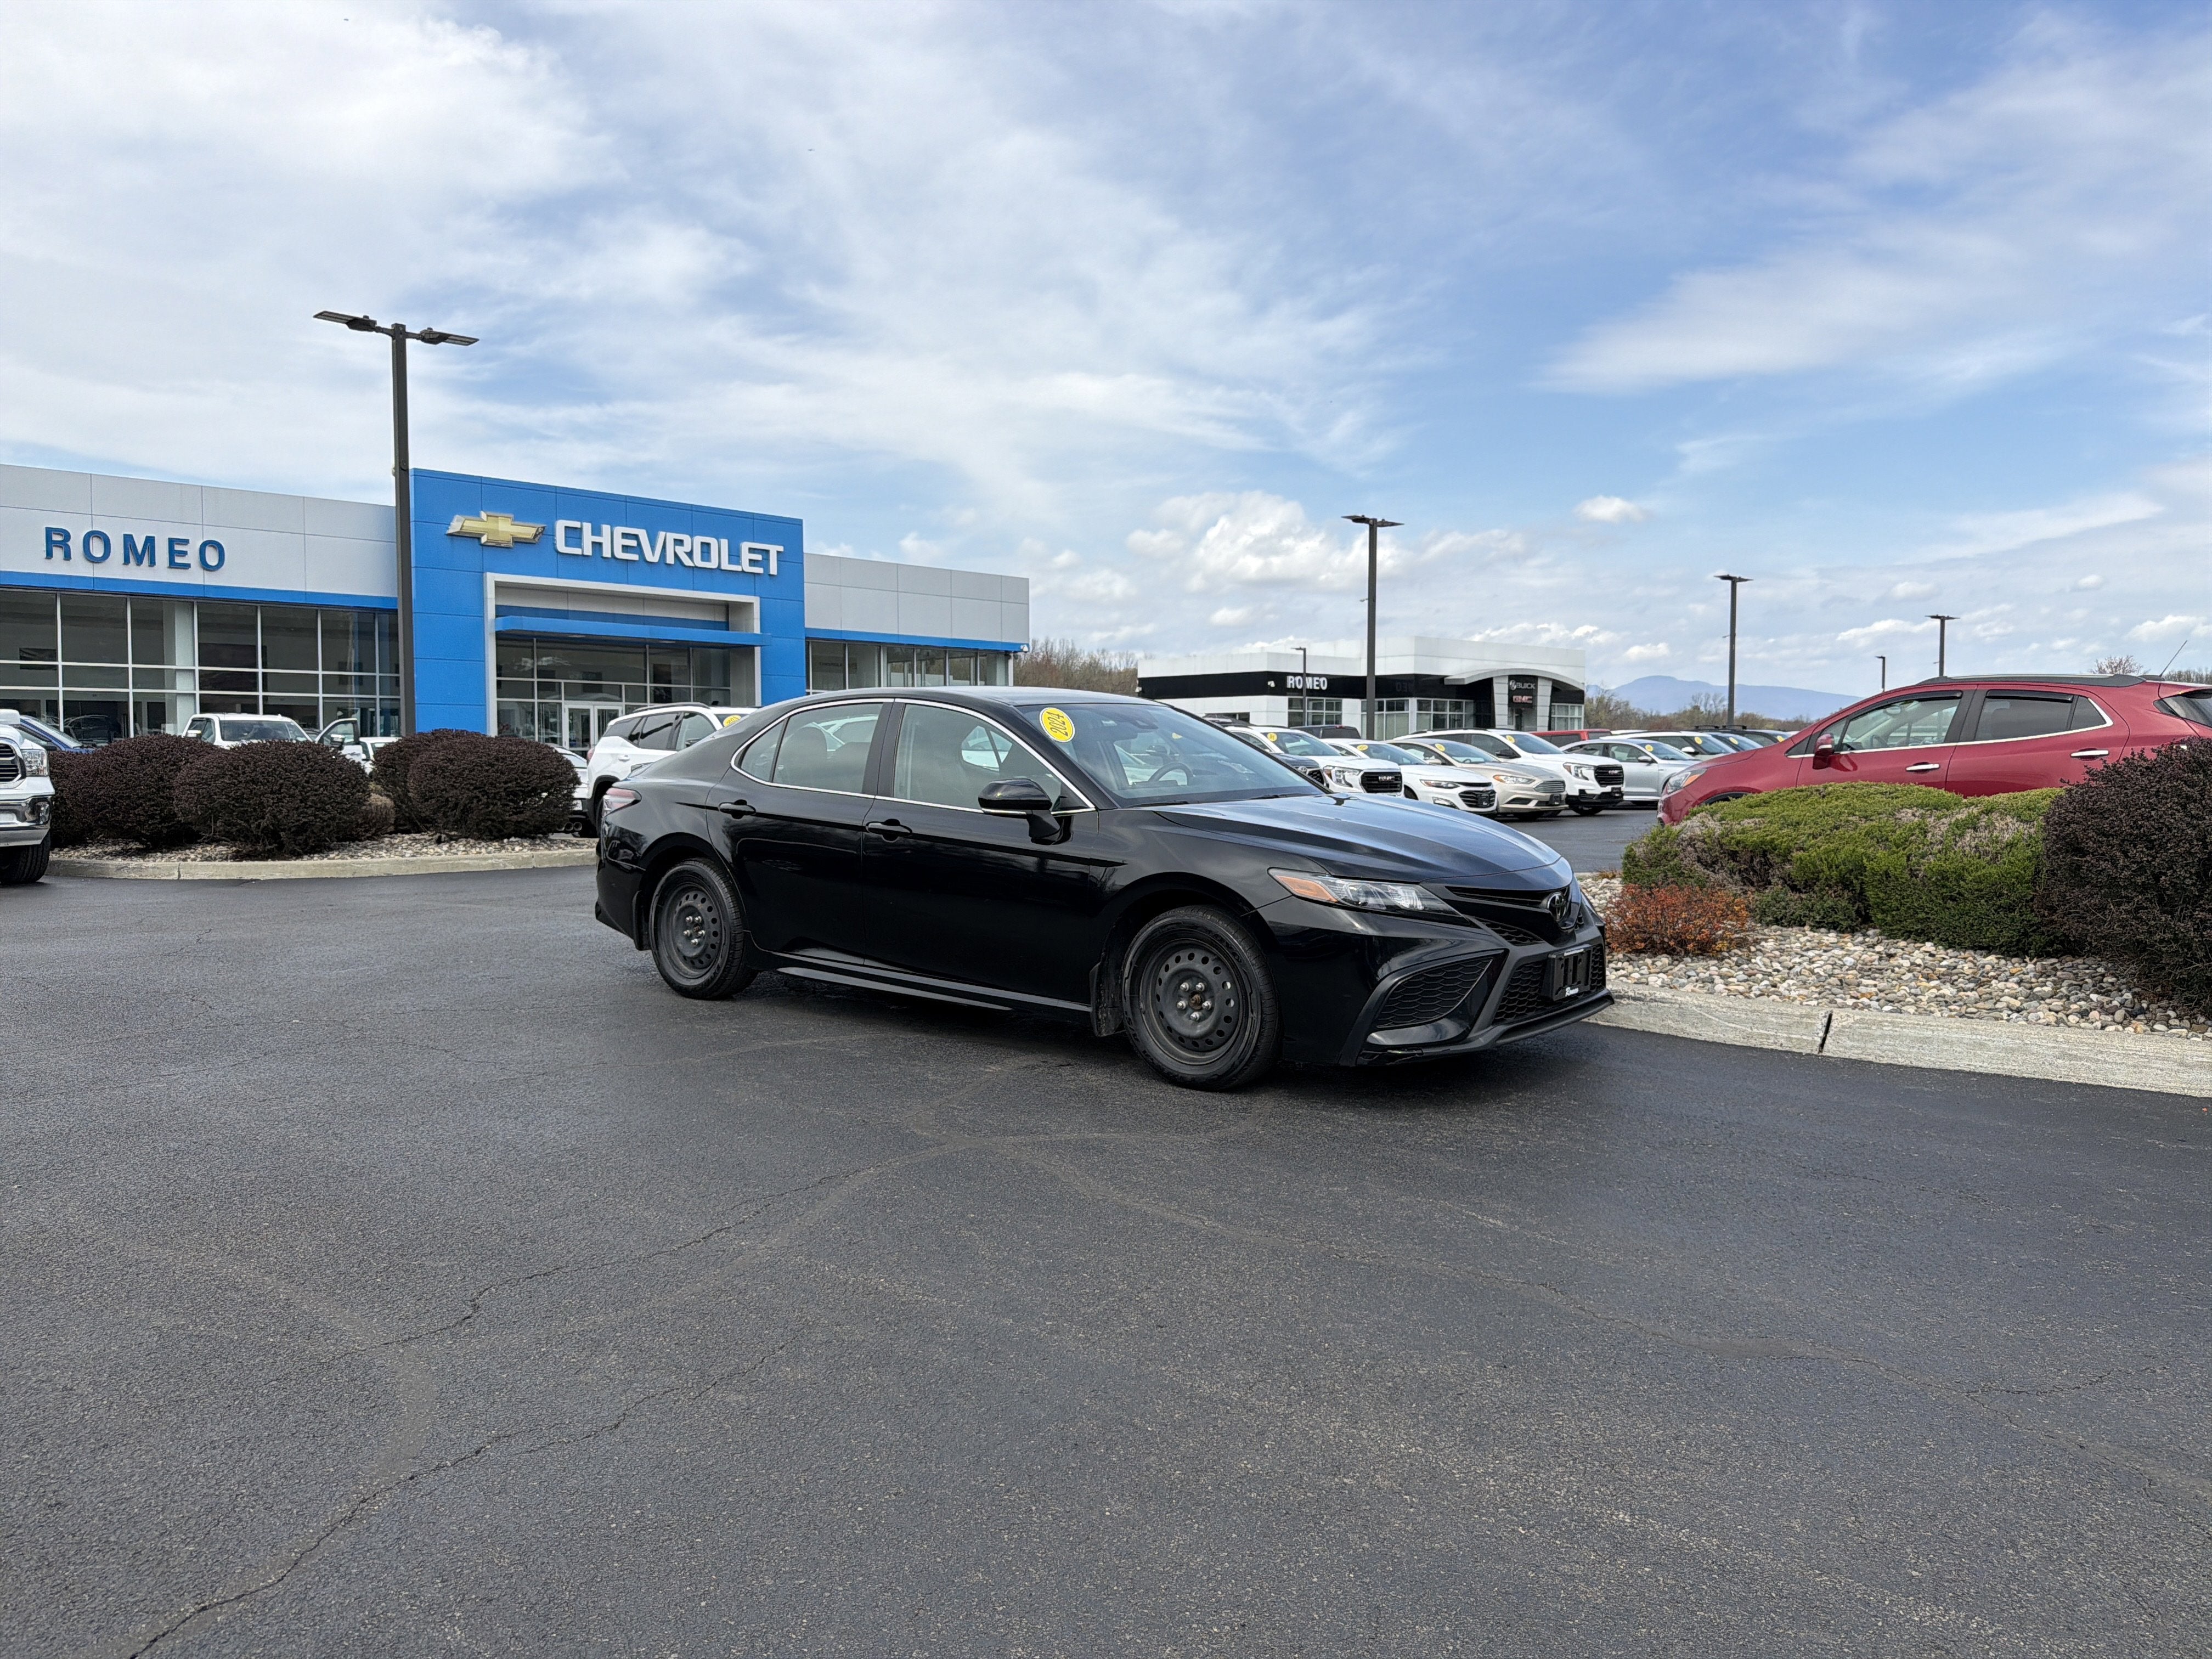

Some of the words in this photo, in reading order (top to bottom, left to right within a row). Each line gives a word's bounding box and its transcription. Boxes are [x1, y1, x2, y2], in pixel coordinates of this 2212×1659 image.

[45, 527, 225, 572] ROMEO
[555, 519, 784, 576] CHEVROLET
[1286, 675, 1328, 690] ROMEO
[1046, 711, 1069, 737] 2024
